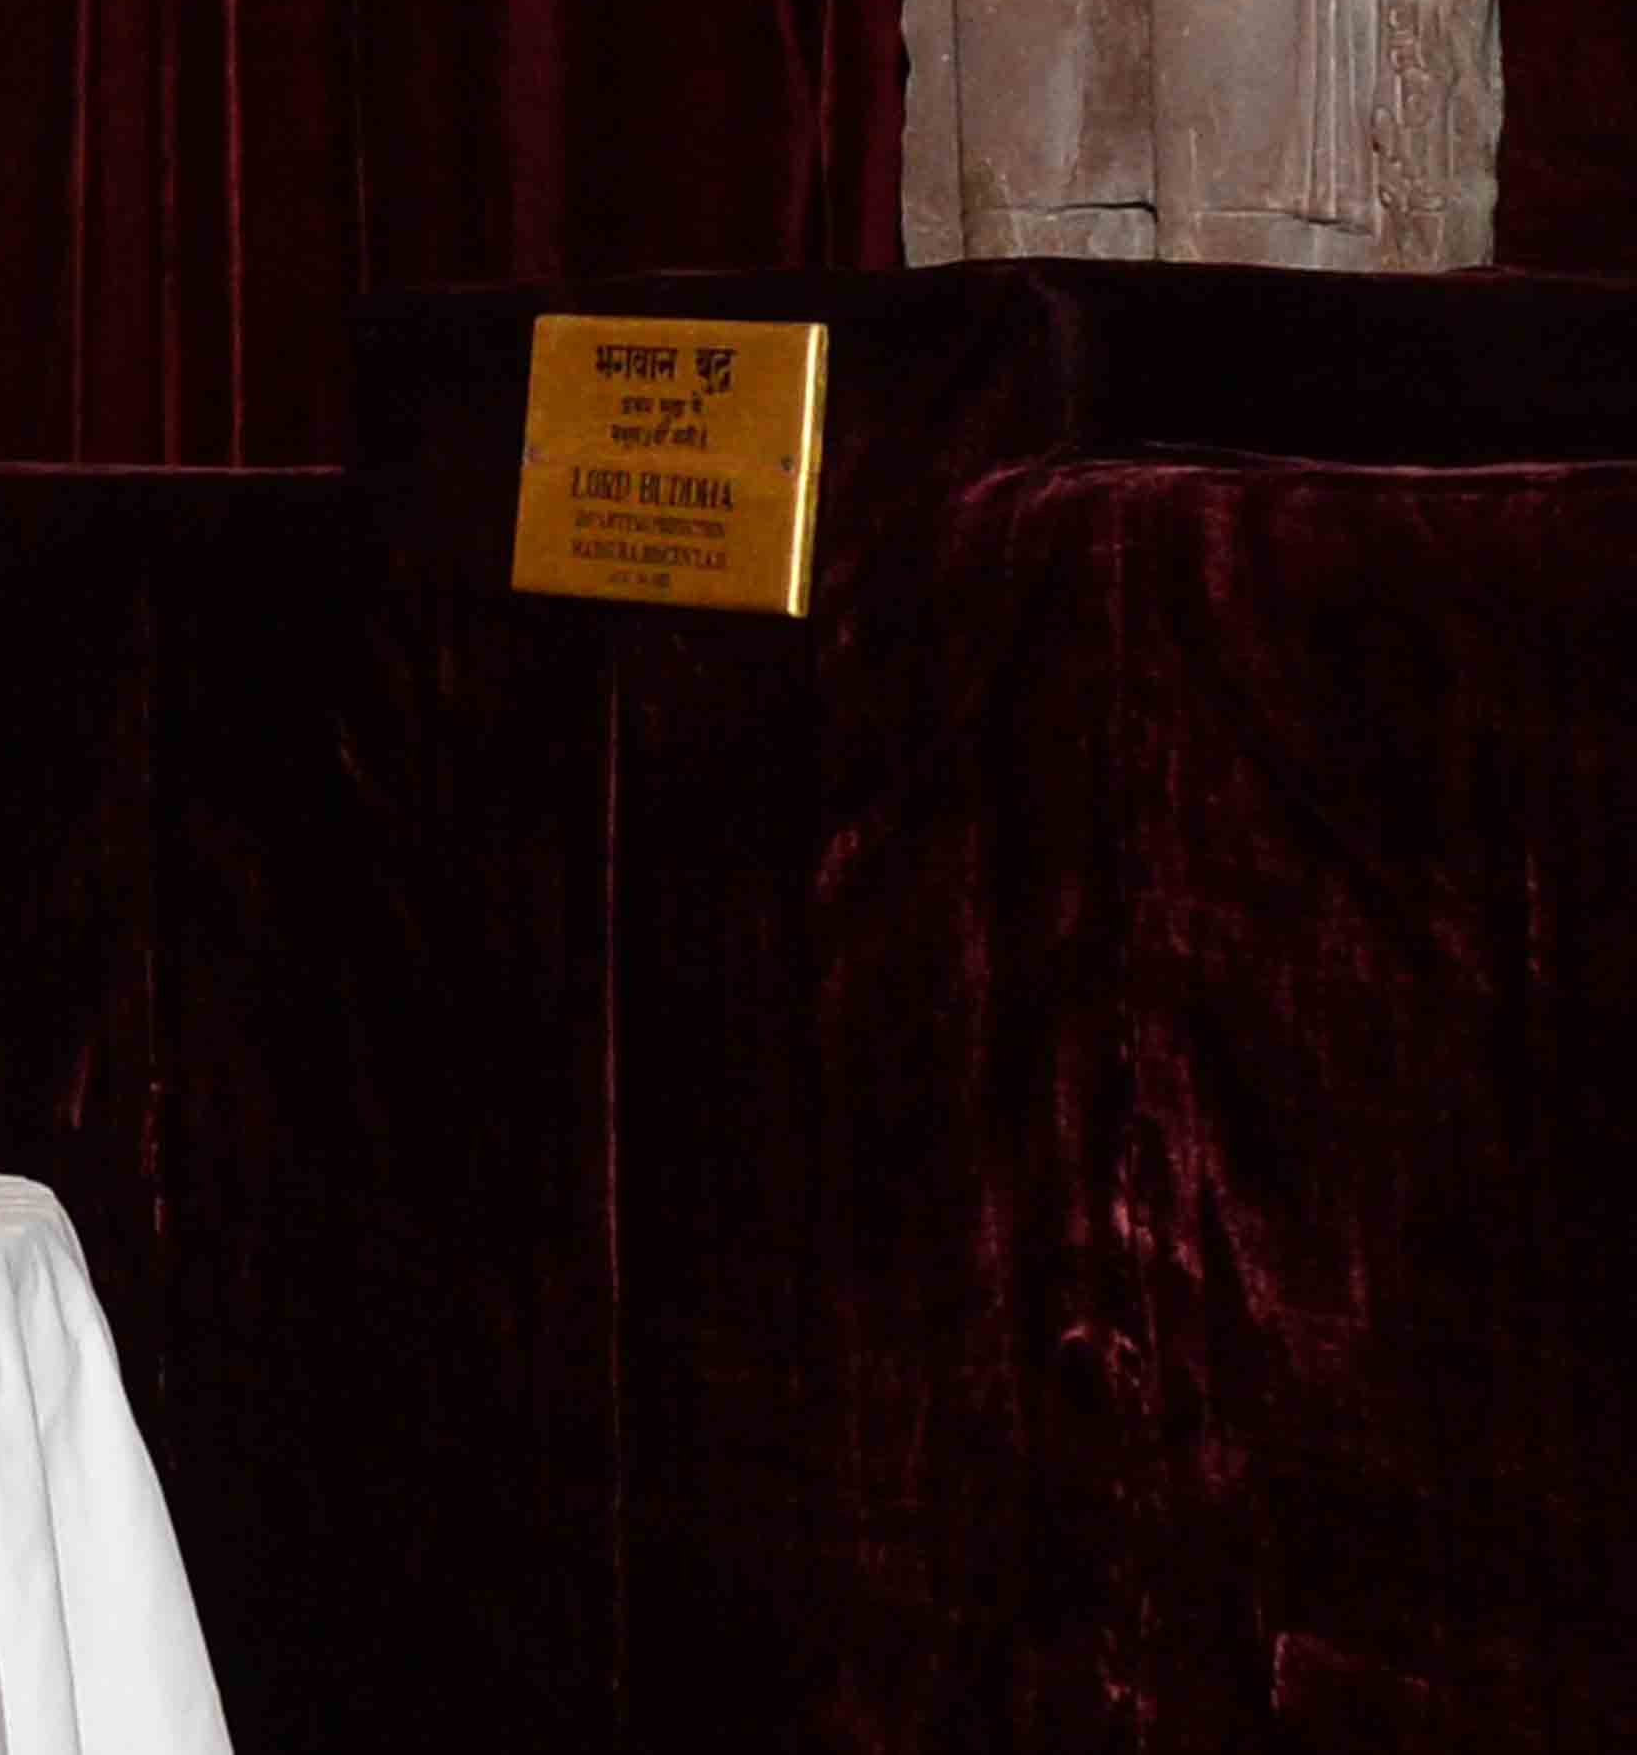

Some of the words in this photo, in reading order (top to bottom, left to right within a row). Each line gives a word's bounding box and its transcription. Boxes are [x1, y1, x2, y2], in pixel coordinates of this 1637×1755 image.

[596, 344, 678, 380] भगवान
[571, 465, 630, 500] LORD
[638, 471, 734, 511] BUDDHA
